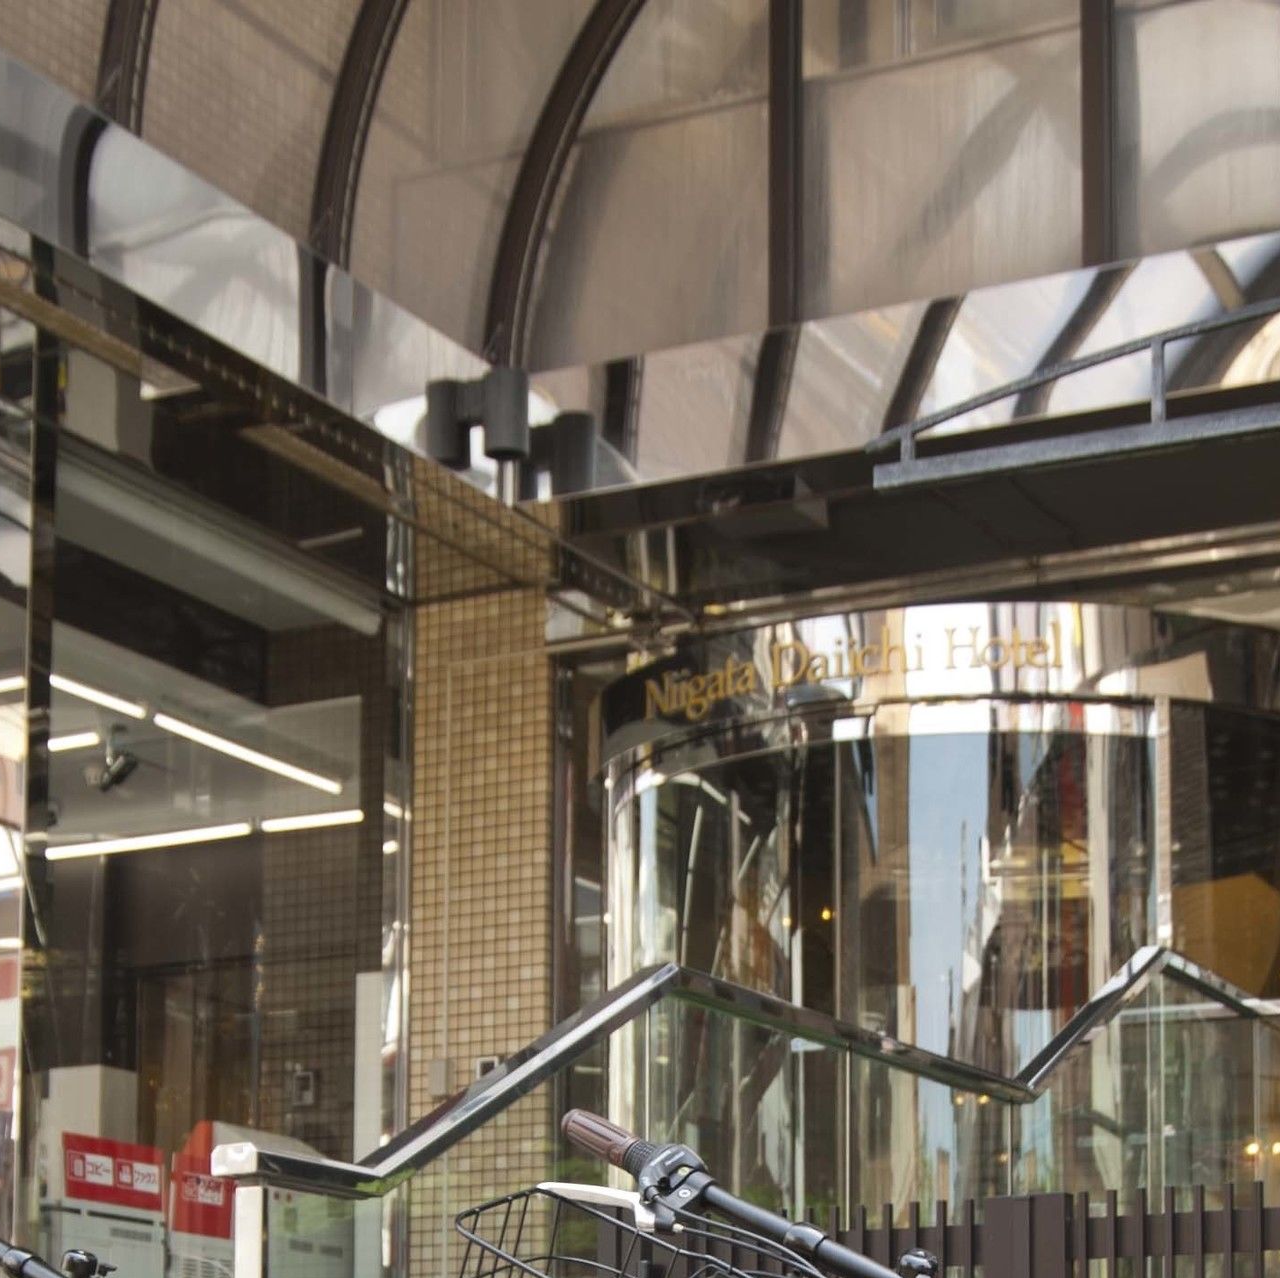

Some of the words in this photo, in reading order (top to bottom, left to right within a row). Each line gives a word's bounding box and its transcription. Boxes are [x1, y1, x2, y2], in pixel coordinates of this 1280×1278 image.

[643, 655, 756, 721] Niigata
[770, 625, 924, 689] Daiichi
[944, 619, 1062, 670] Hotel
